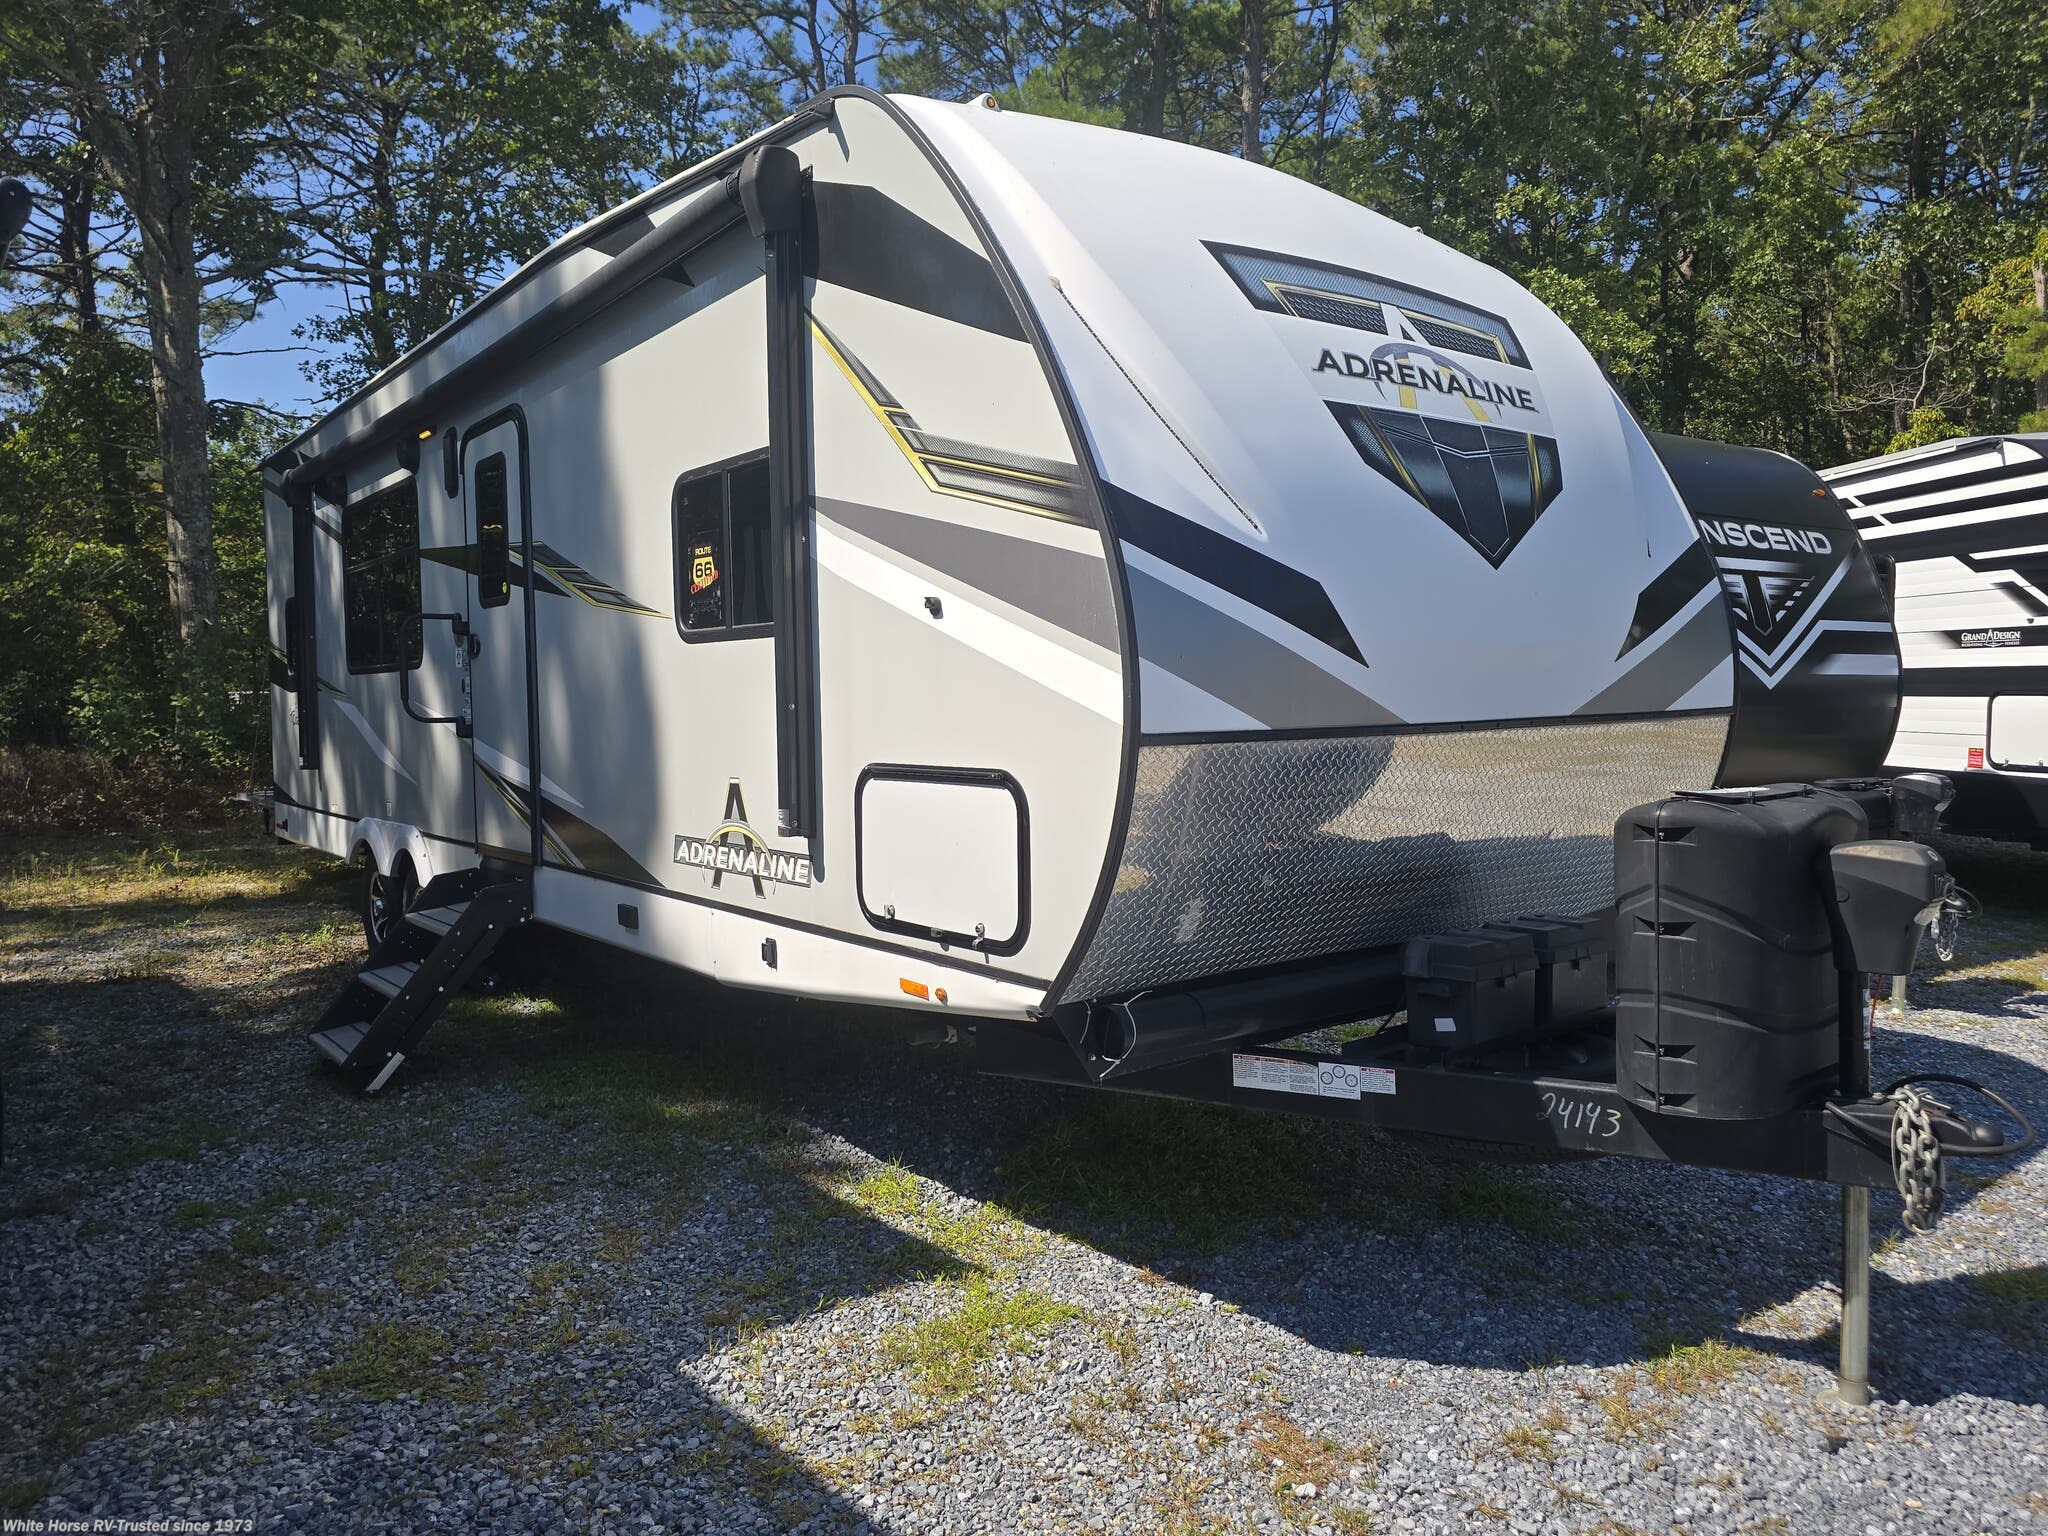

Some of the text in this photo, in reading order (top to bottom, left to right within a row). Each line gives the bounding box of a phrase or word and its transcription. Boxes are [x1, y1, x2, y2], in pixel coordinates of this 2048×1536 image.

[1312, 348, 1539, 414] ADRENALINE
[695, 546, 711, 556] ROUTE
[695, 561, 712, 579] 66
[1961, 630, 2020, 641] GRAND DESIGN
[676, 840, 810, 884] ADRENALINE
[1536, 1092, 1621, 1137] 24143
